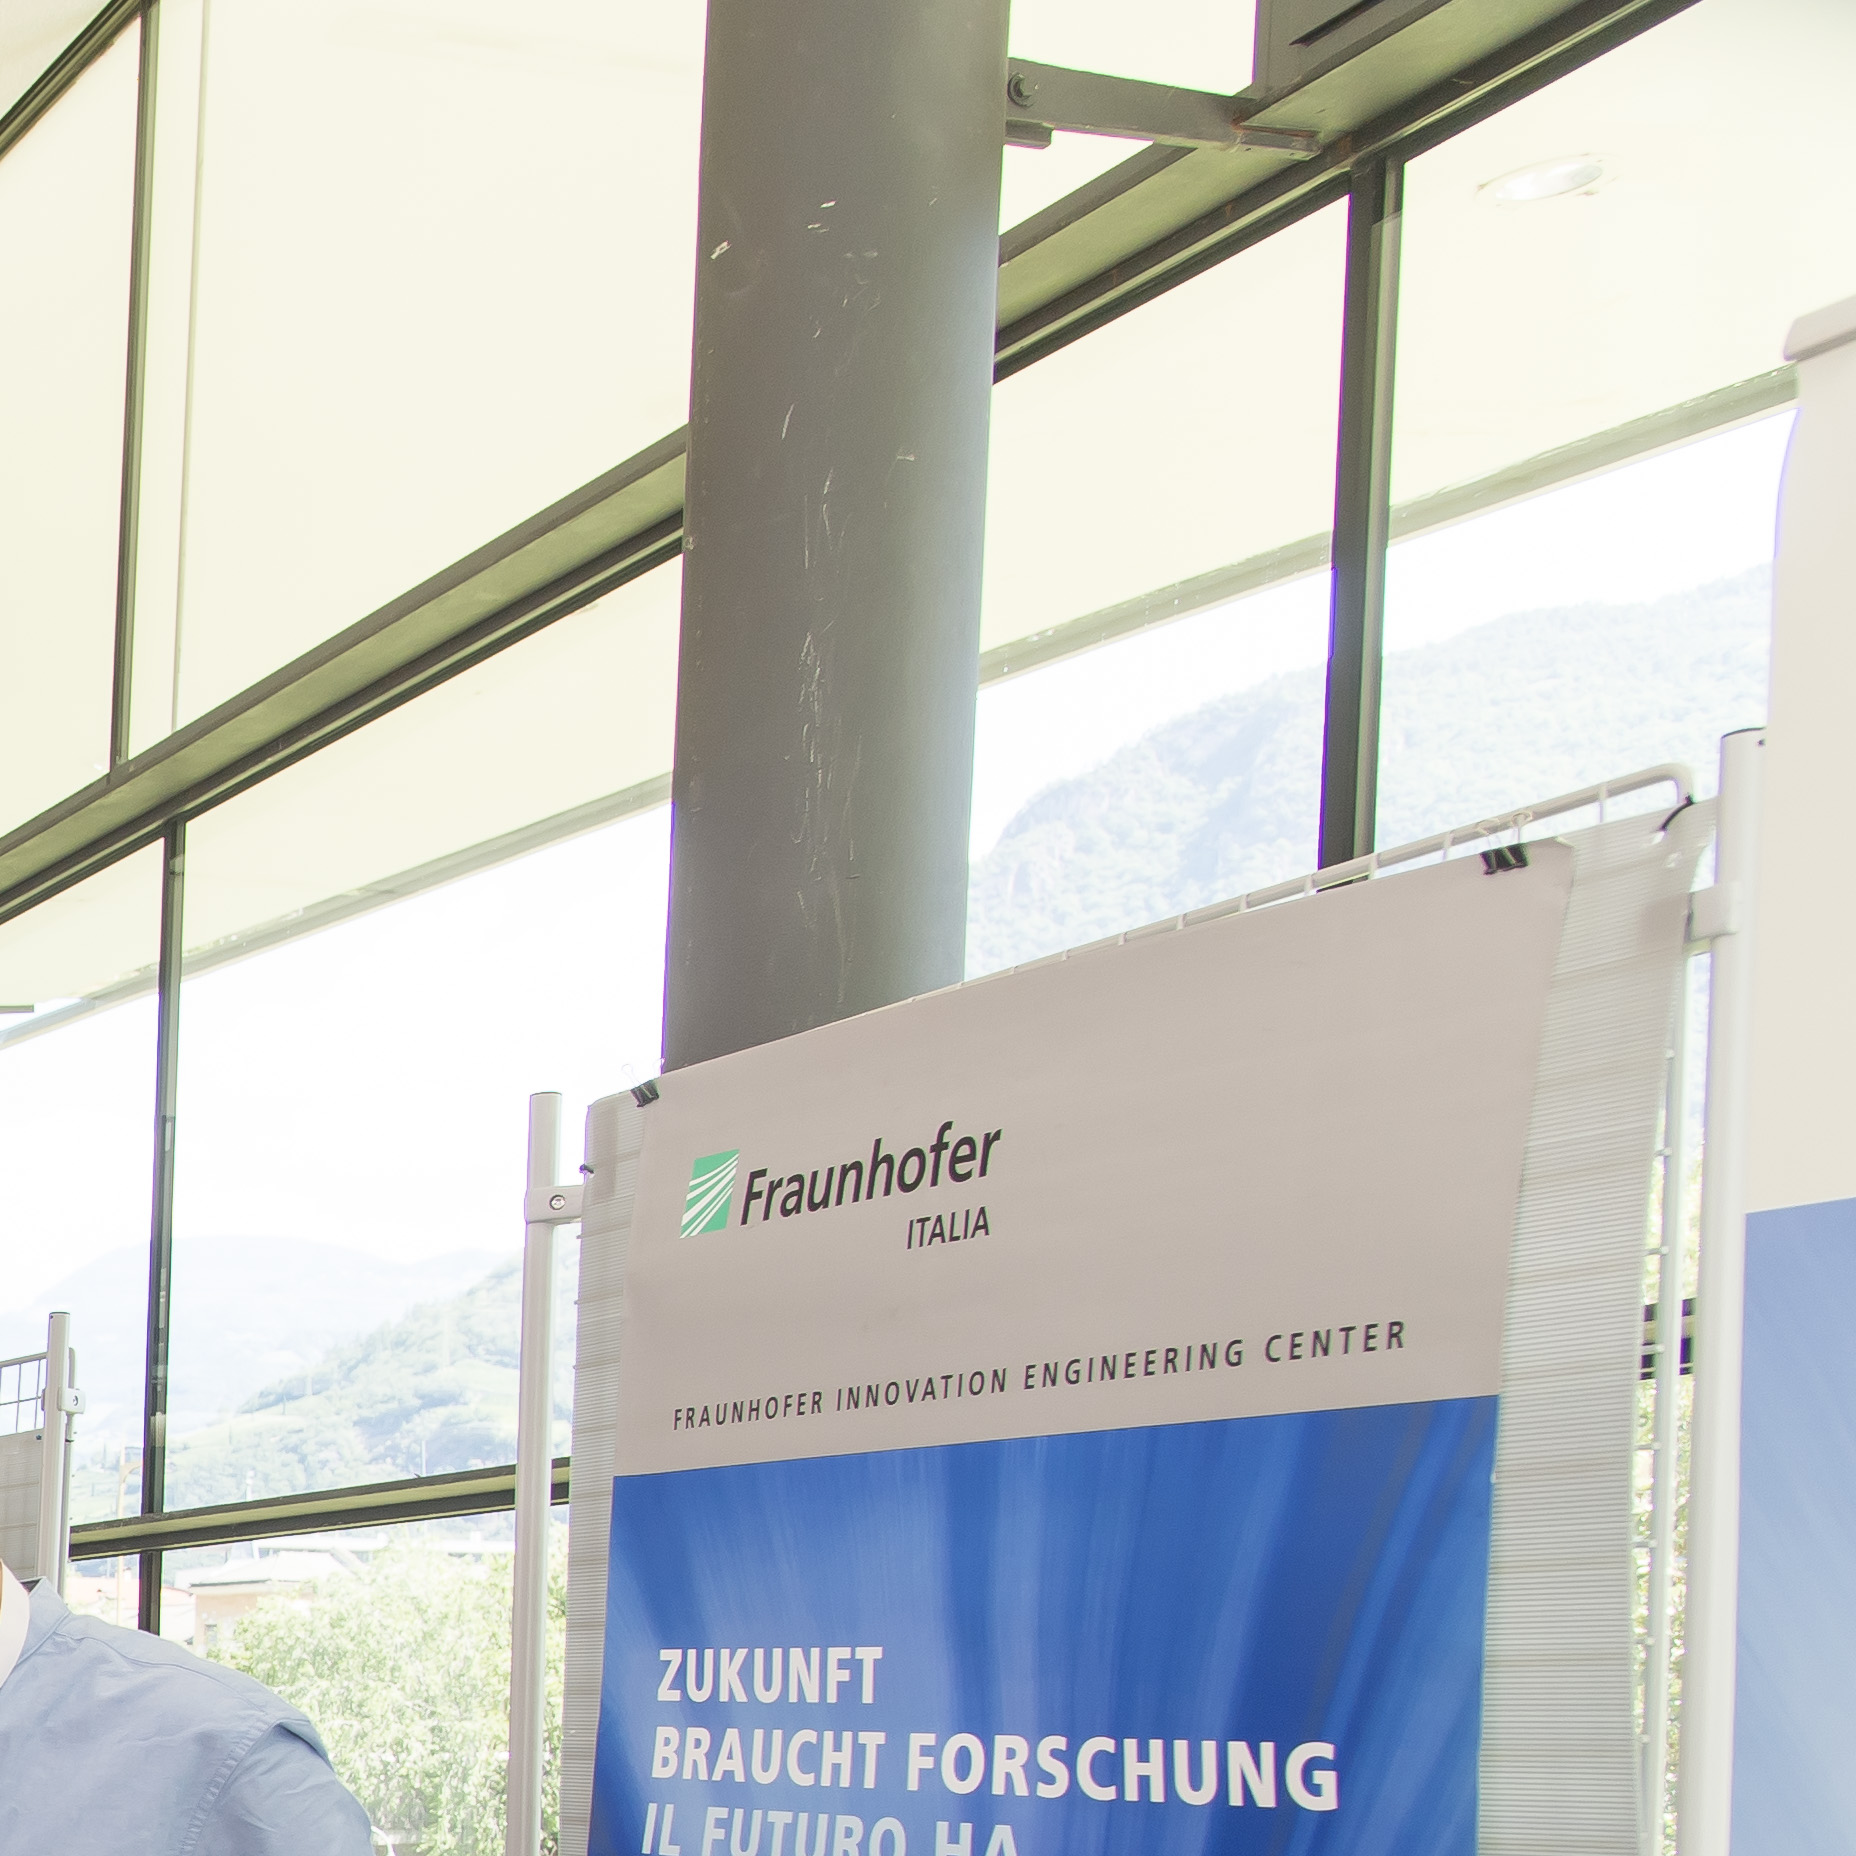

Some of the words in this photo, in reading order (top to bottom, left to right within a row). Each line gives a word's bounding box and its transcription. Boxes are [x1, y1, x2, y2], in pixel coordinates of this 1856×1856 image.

[740, 1121, 1002, 1227] Fraunhofer
[904, 1205, 991, 1251] ITALIA
[672, 1390, 824, 1431] FRAUNHOFER
[835, 1368, 1009, 1413] INNOVATION
[1022, 1338, 1245, 1392] ENGINEERING
[1264, 1319, 1408, 1363] CENTER
[656, 1646, 884, 1706] ZUKUNFT
[650, 1726, 885, 1790] BRAUCHT
[905, 1732, 1341, 1813] FORSCHUNG
